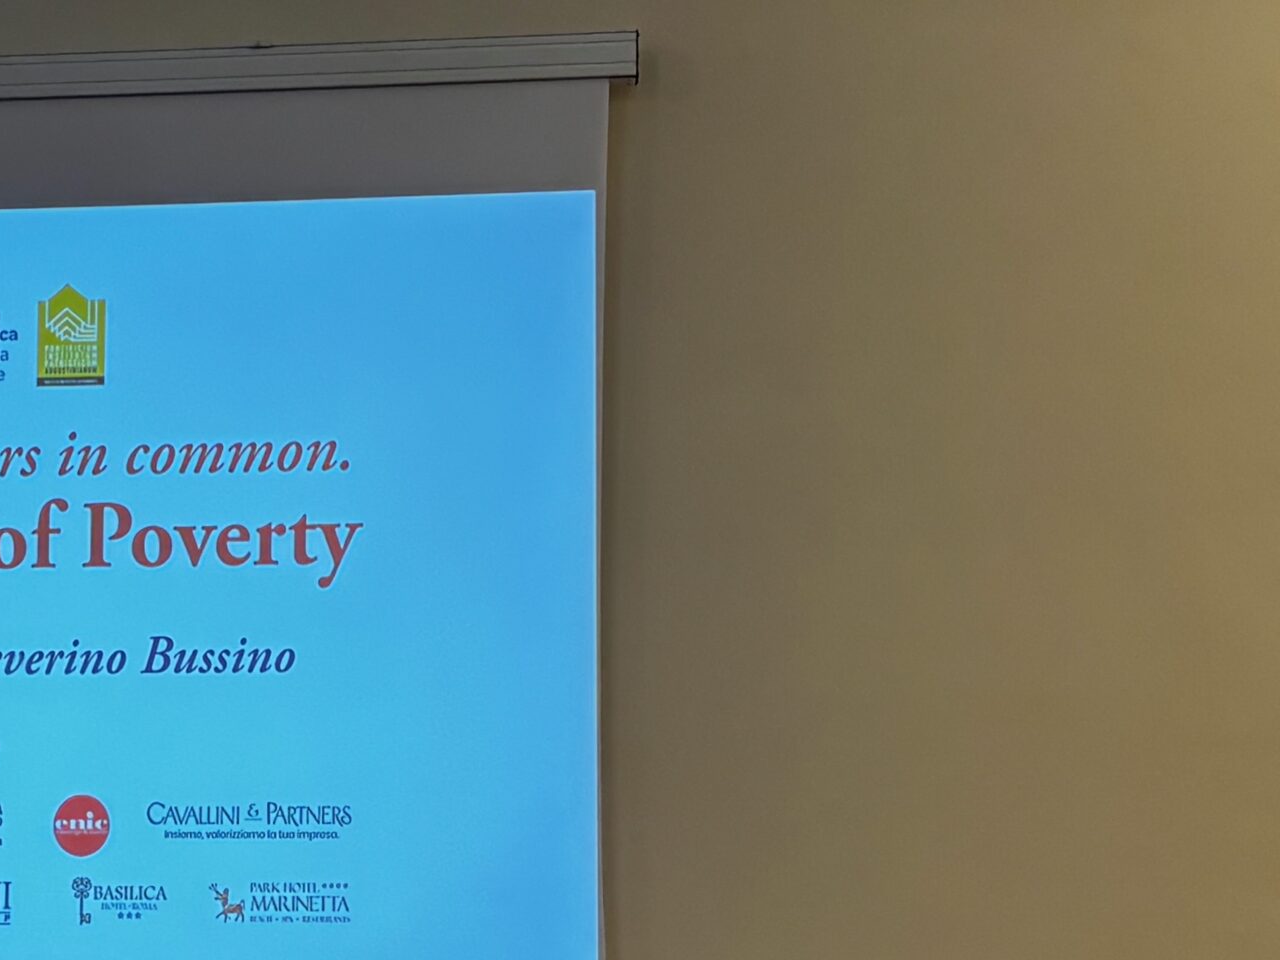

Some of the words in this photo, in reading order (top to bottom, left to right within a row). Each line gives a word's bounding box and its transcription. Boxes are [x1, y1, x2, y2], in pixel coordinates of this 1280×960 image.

[58, 431, 108, 477] in
[125, 440, 351, 475] common.
[82, 502, 364, 589] Poverty
[140, 636, 296, 675] Bussino
[246, 803, 260, 818] &
[55, 810, 108, 831] enic
[266, 829, 277, 840] la
[278, 829, 295, 840] tua
[92, 884, 168, 901] BASILICA
[250, 882, 280, 894] PARK
[283, 882, 317, 894] HOTEL
[250, 895, 350, 913] MARINETTA
